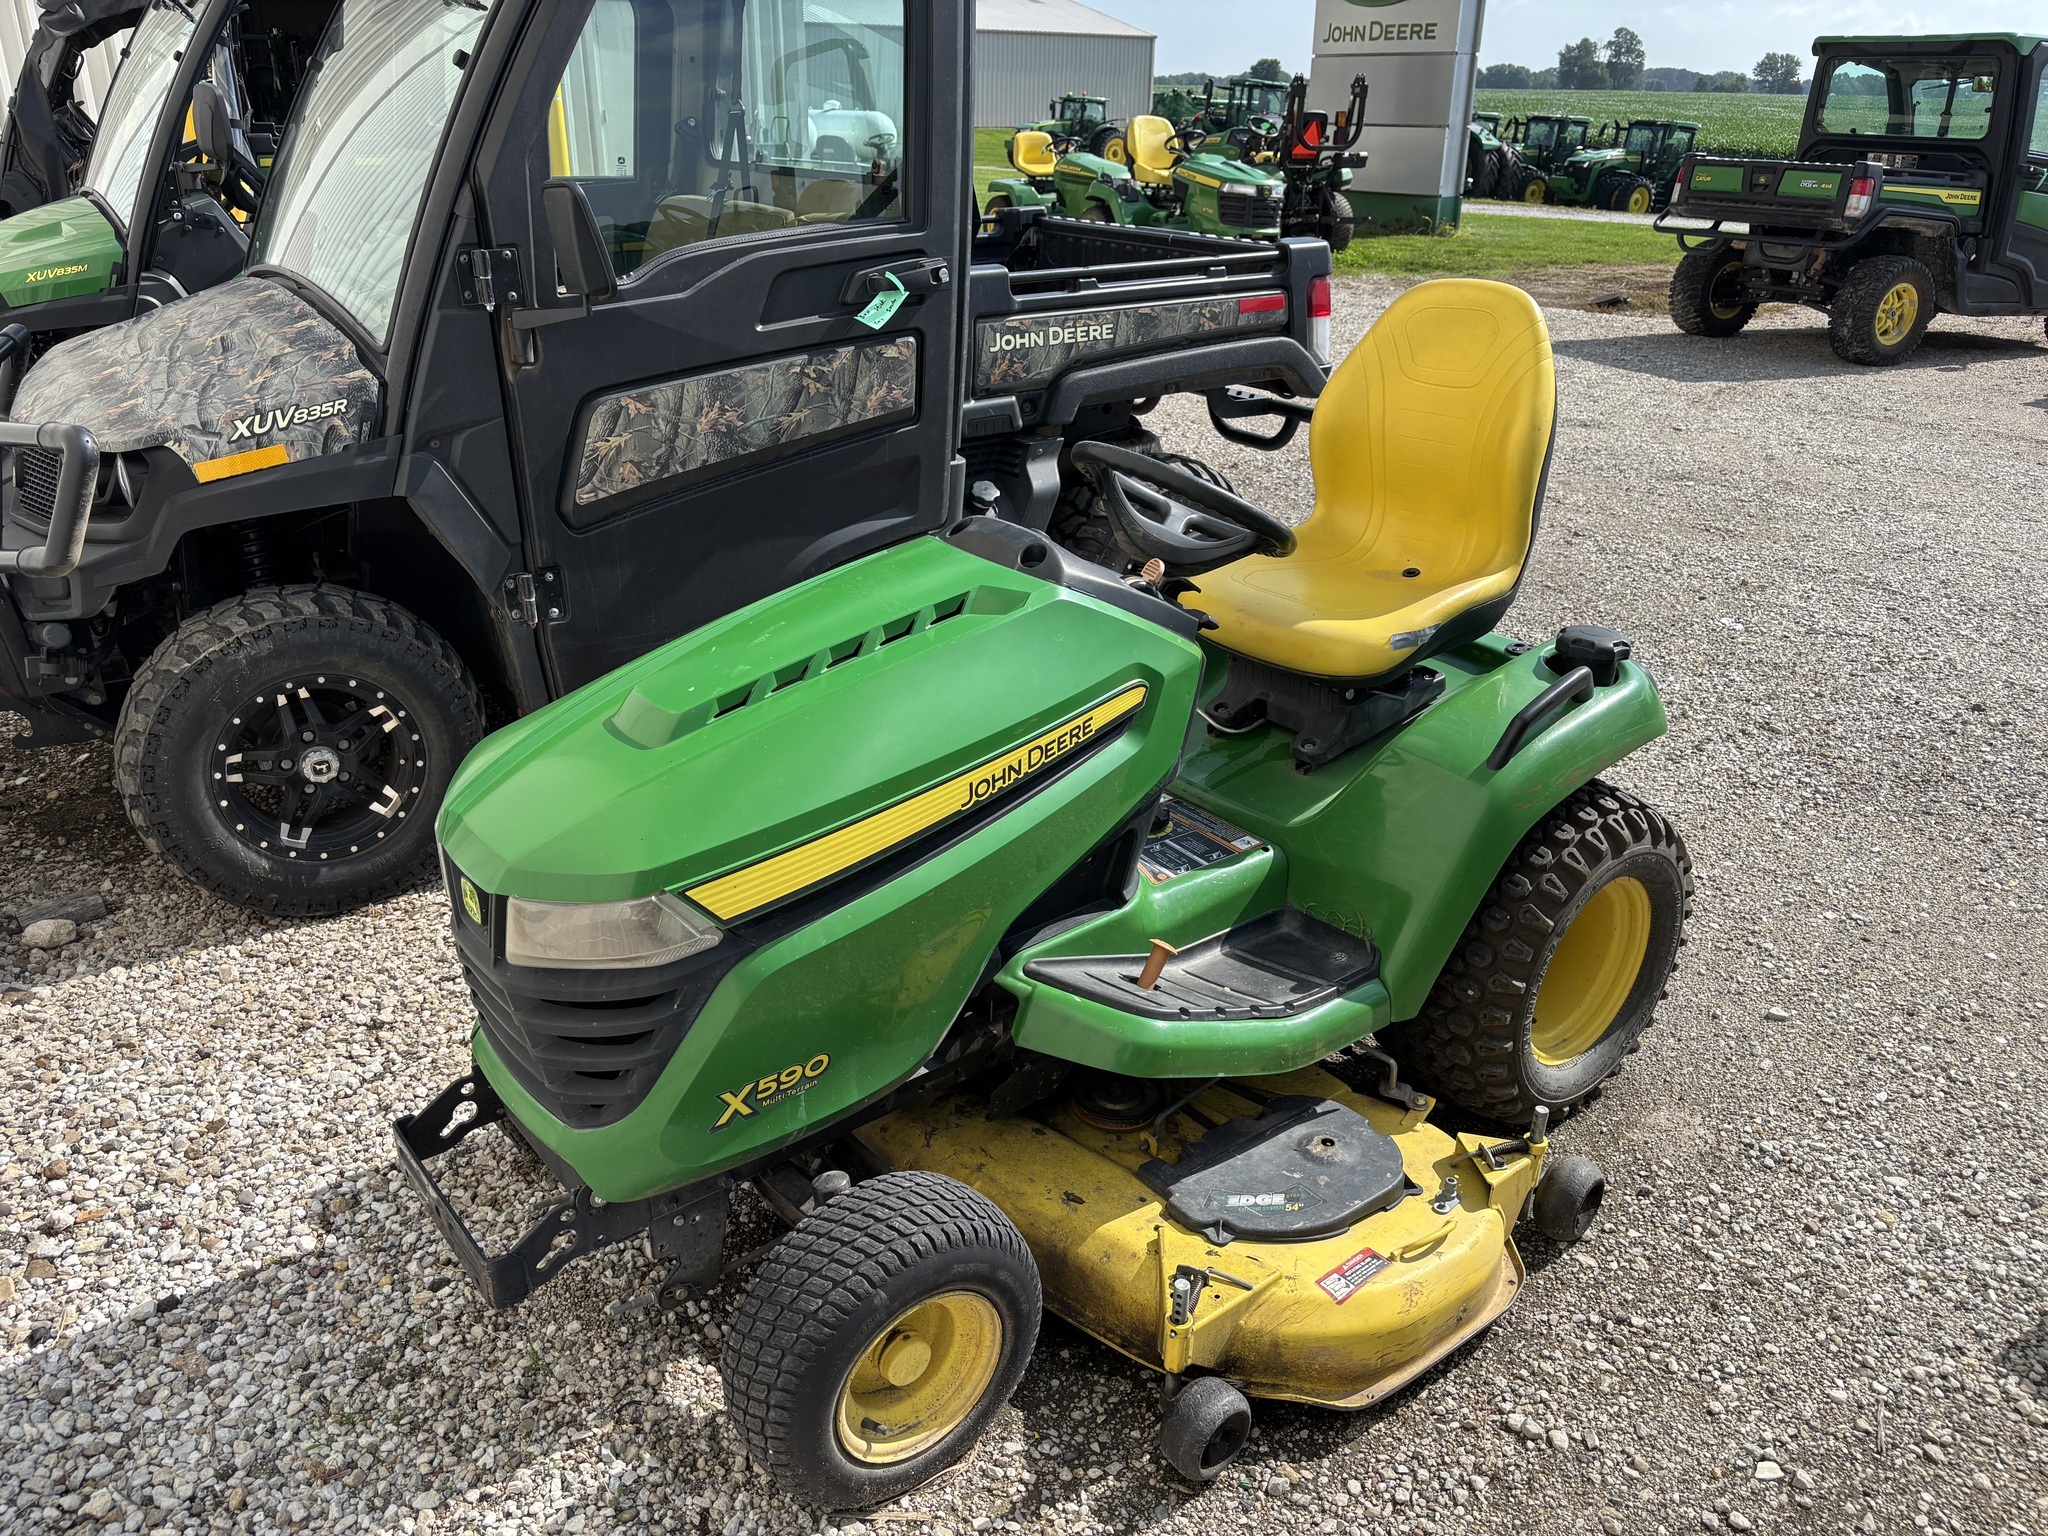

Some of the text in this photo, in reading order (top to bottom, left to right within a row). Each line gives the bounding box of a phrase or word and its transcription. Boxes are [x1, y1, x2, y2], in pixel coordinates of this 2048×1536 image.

[1323, 21, 1438, 43] JOHN DEERE
[1960, 192, 1978, 201] DEERE
[25, 263, 88, 283] XUV835M
[989, 323, 1114, 353] JOHN DEERE
[228, 399, 349, 443] XUV835R
[960, 715, 1094, 810] JOHN DEERE
[711, 1053, 830, 1131] X590
[761, 1079, 818, 1108] Multi-Terrain
[1226, 1193, 1286, 1207] EDGE
